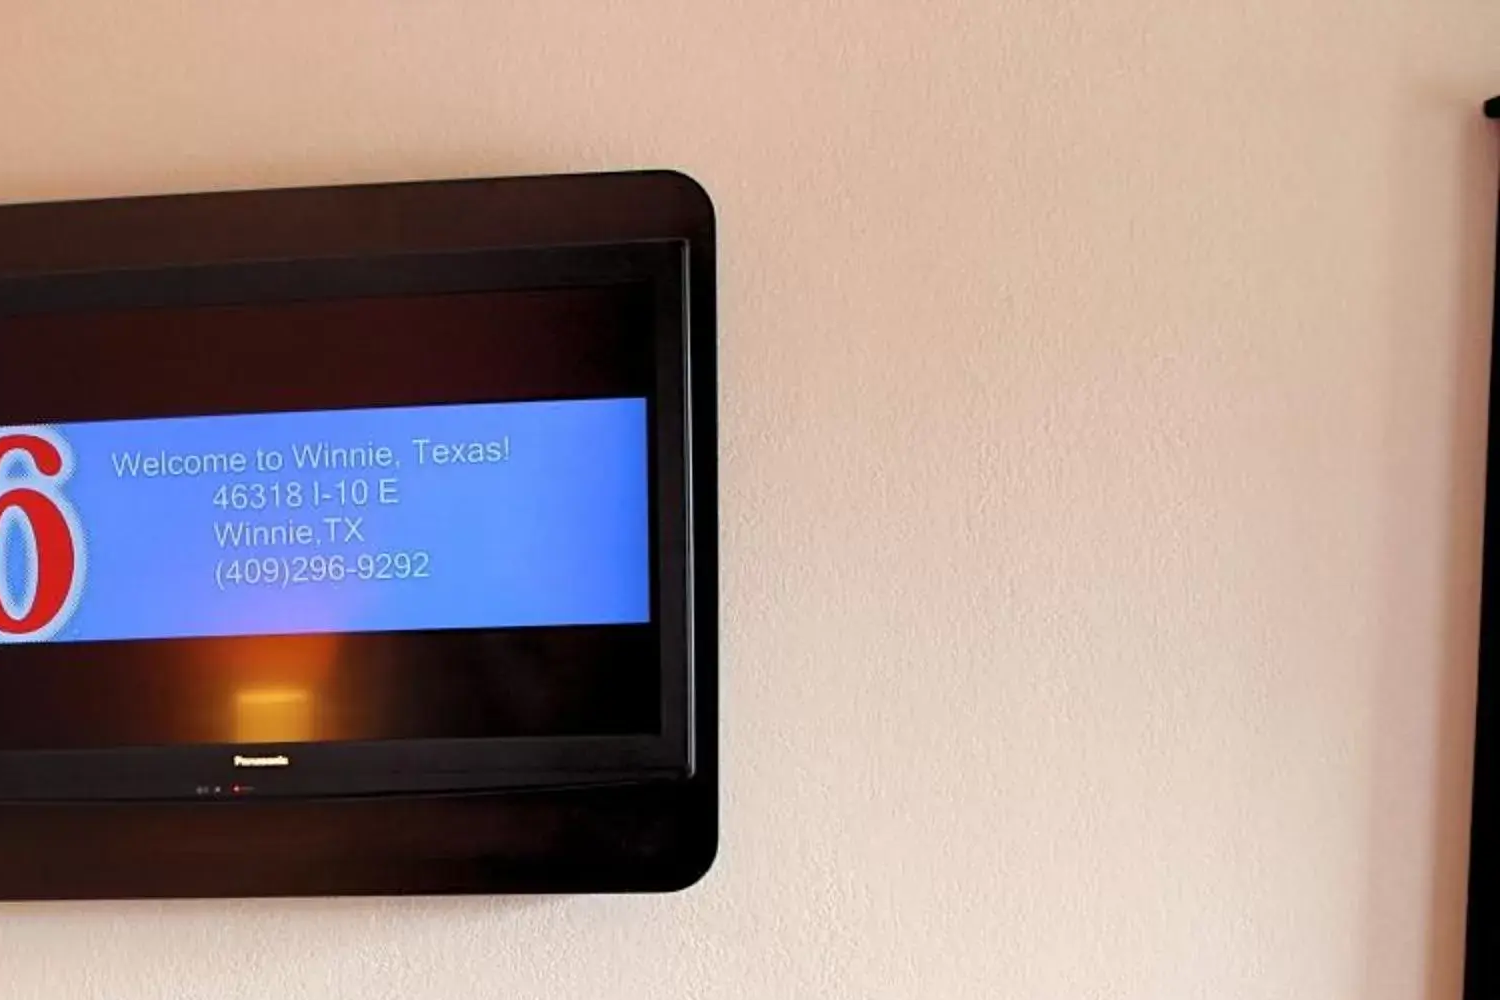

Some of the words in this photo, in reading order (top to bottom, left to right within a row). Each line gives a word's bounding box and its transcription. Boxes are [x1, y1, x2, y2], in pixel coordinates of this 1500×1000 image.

[111, 451, 247, 477] Welcome
[257, 449, 282, 471] to
[412, 436, 509, 465] Texas!
[213, 482, 302, 510] 46318
[313, 479, 368, 505] I-10
[379, 478, 399, 504] E
[215, 552, 430, 590] (409)296-9292
